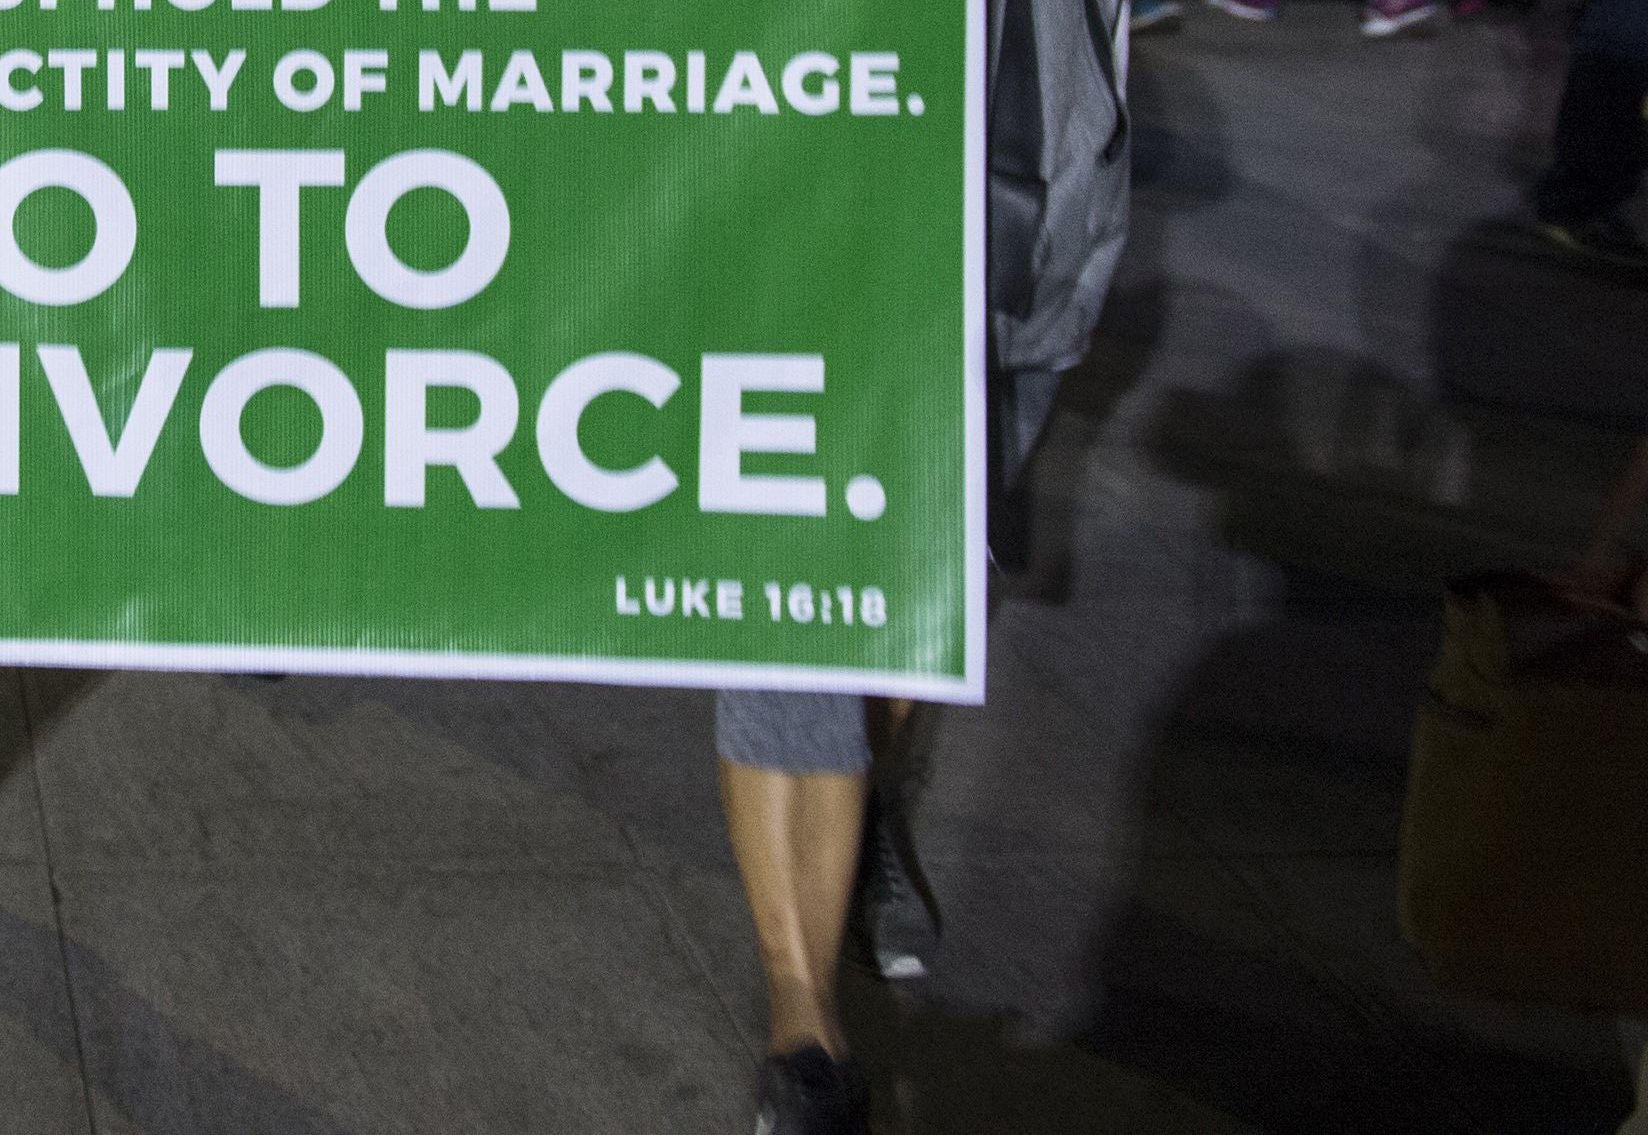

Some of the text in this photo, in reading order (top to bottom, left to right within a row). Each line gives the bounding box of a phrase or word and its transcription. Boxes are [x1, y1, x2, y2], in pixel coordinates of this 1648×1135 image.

[273, 50, 389, 112] OF
[418, 50, 925, 116] MARRIAGE.
[214, 148, 511, 310] TO
[614, 575, 888, 628] LUKE 16:18
